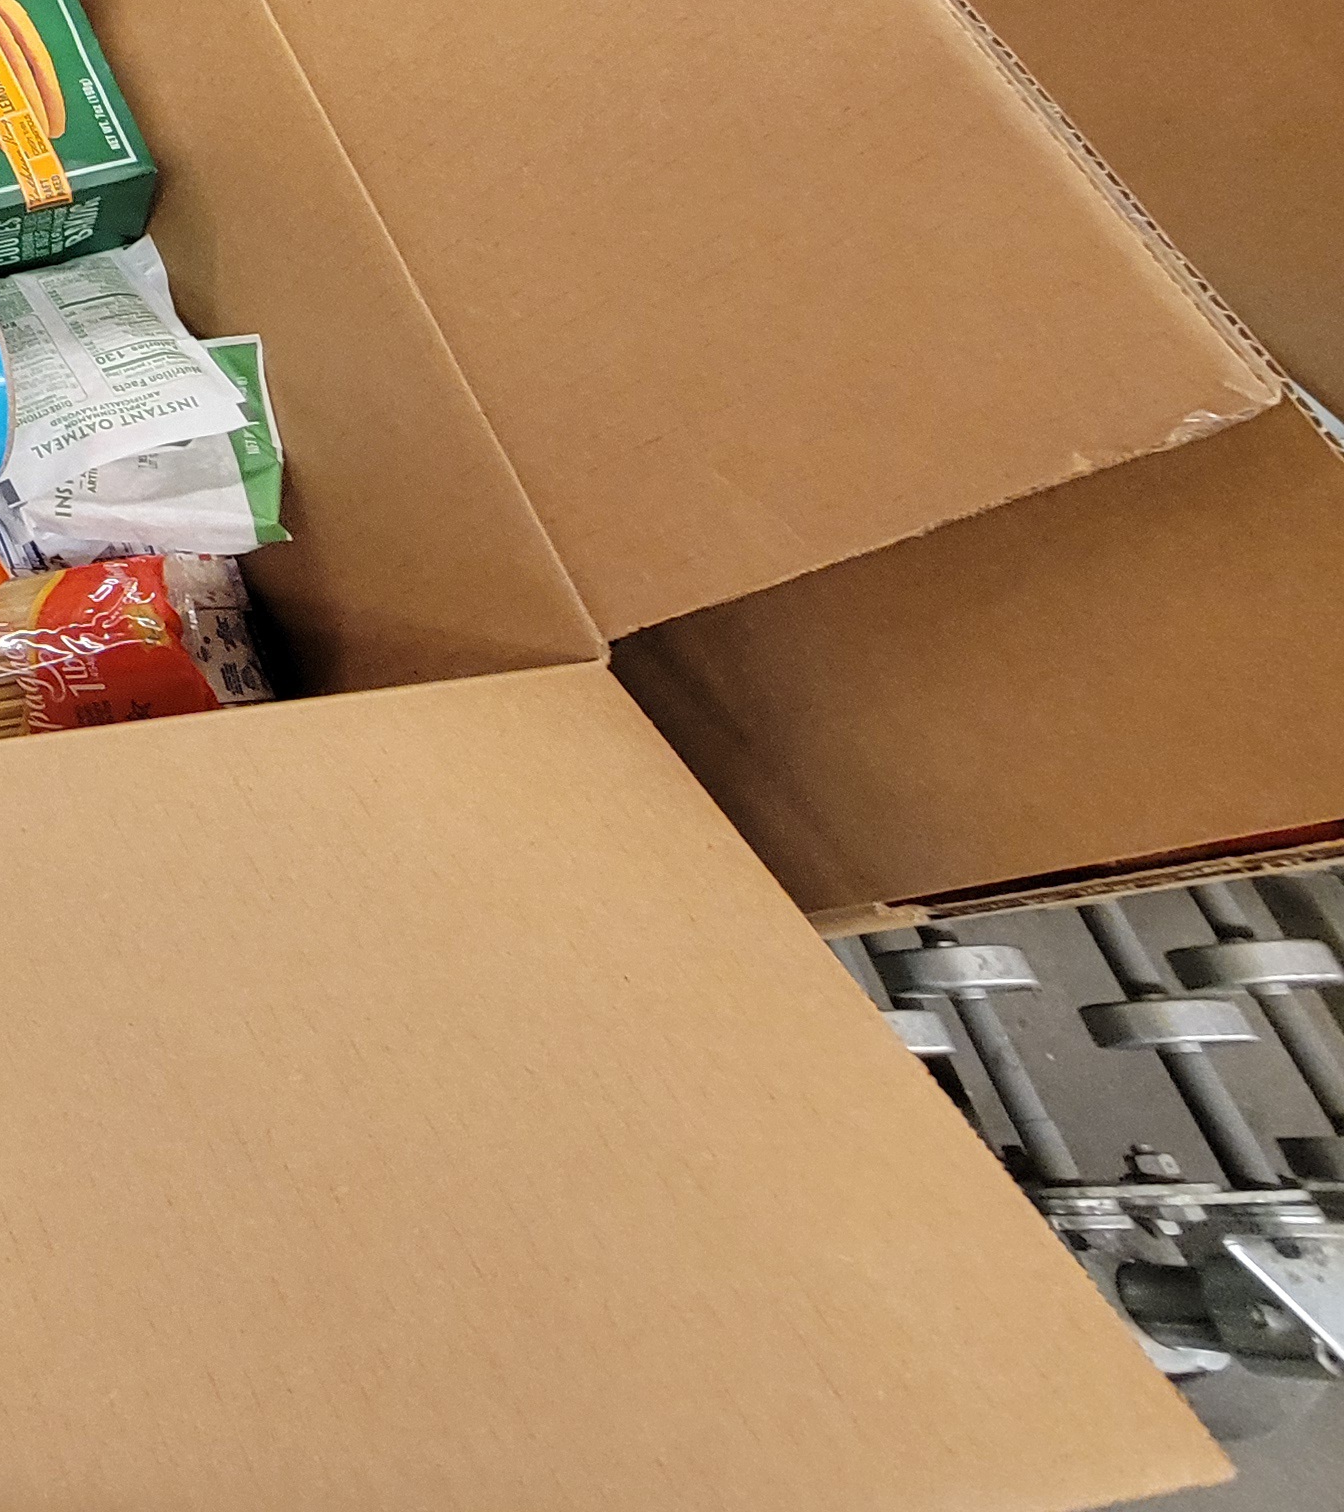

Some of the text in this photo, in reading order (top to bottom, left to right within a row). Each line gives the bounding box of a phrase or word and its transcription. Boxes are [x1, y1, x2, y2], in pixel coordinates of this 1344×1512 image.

[96, 350, 125, 366] 130
[113, 366, 202, 392] Nutrition Facts
[30, 395, 199, 459] INSTANT OATMEAL
[55, 479, 75, 518] INS
